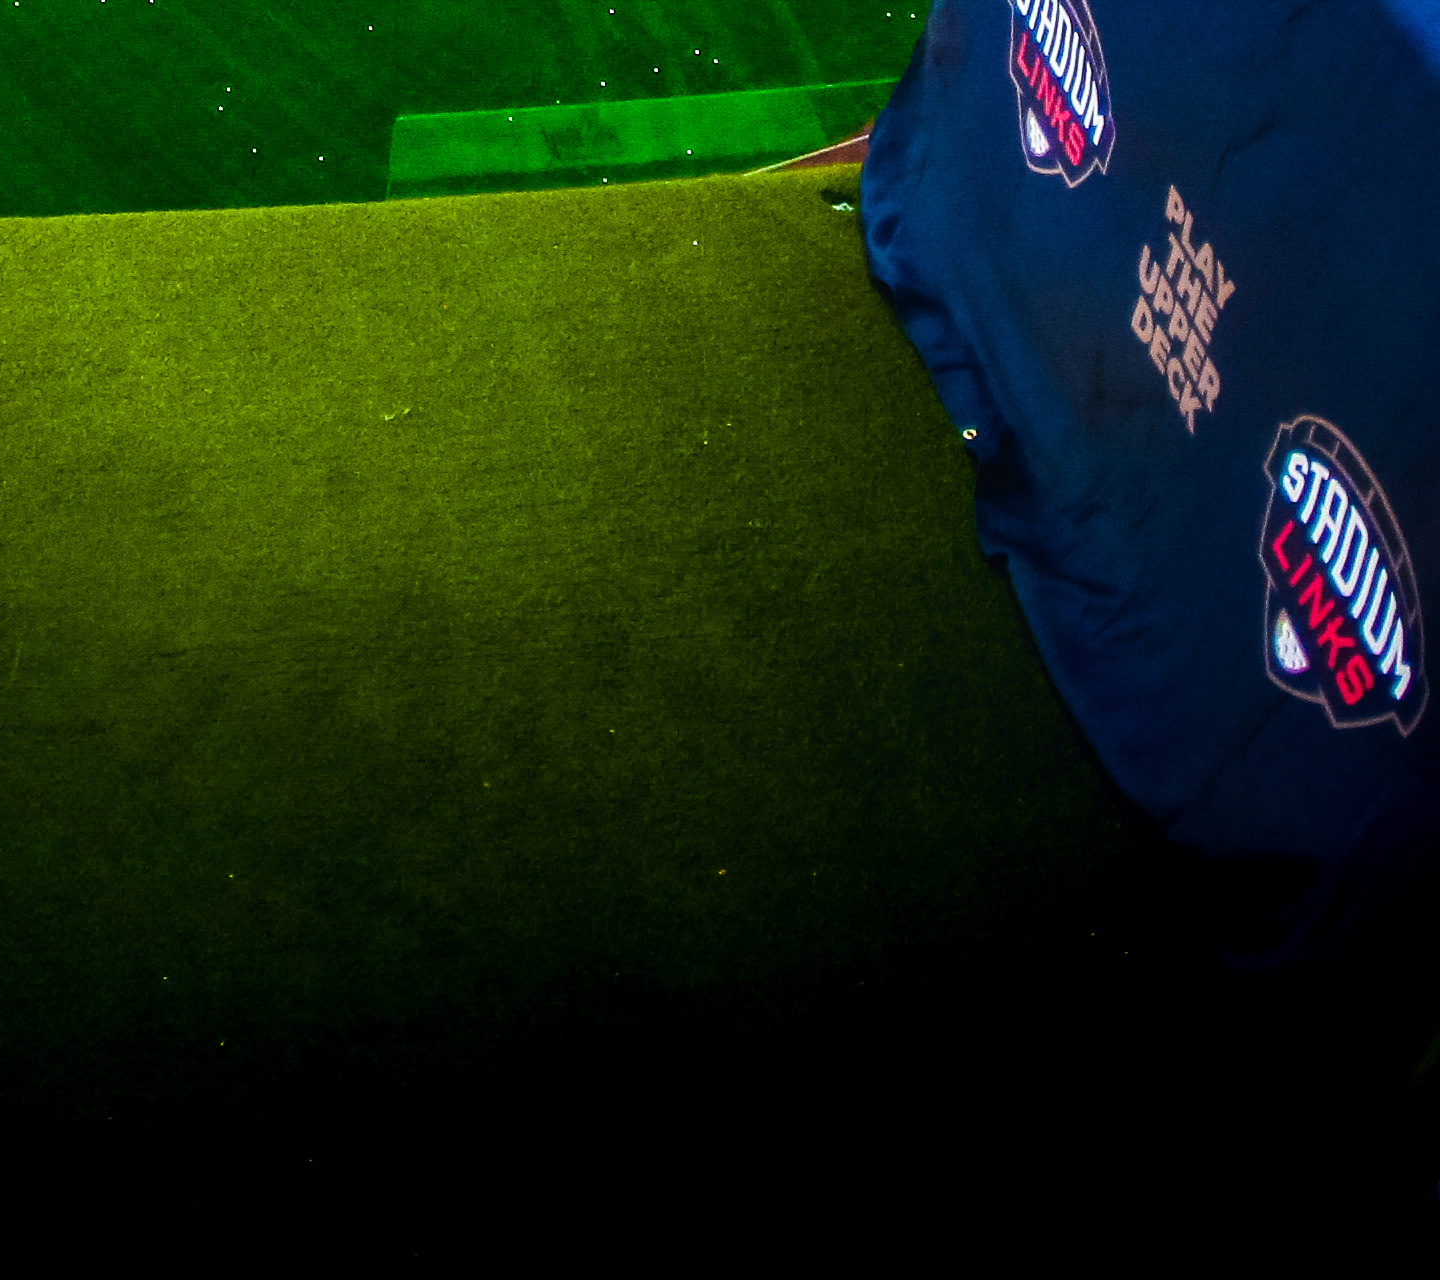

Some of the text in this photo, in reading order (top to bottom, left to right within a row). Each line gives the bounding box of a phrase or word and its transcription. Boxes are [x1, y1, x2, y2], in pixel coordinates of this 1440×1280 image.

[1016, 33, 1086, 167] LINKS
[1165, 183, 1237, 310] PLAY
[1165, 231, 1219, 346] THE
[1130, 294, 1202, 437] DECK
[1138, 244, 1221, 414] UPPER
[1271, 518, 1373, 709] LINKS
[1281, 449, 1414, 703] STADIUM
